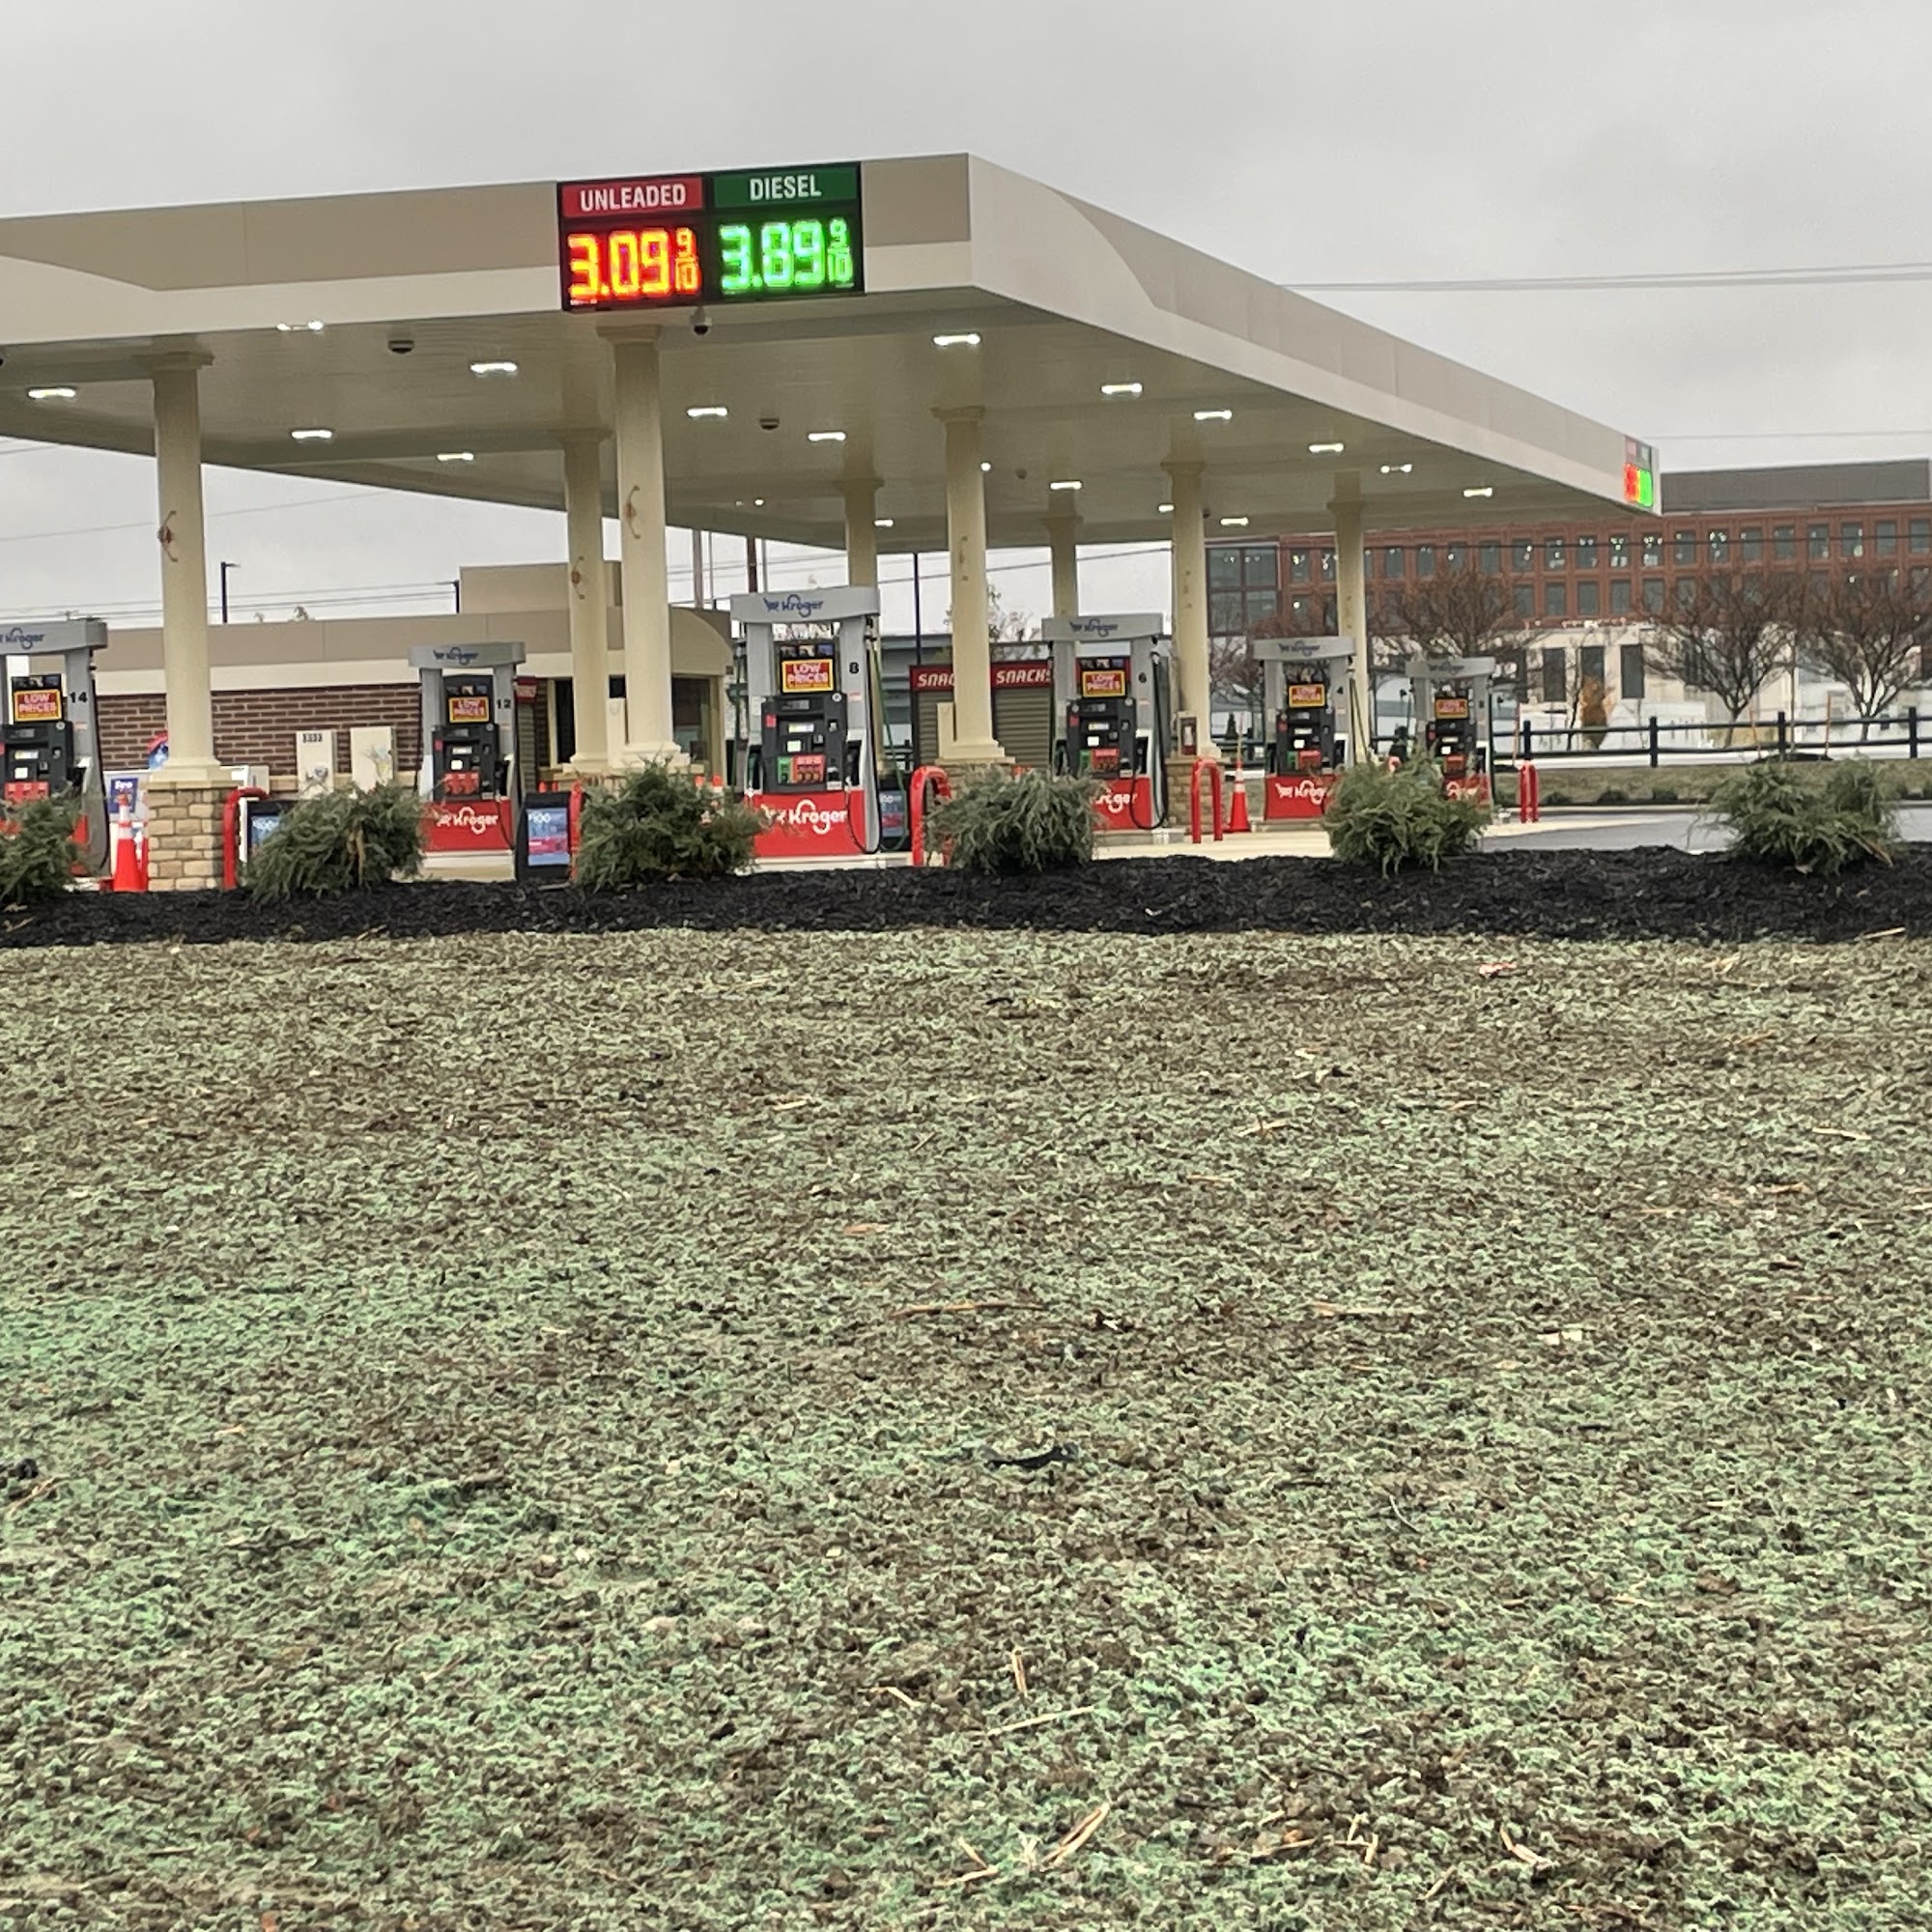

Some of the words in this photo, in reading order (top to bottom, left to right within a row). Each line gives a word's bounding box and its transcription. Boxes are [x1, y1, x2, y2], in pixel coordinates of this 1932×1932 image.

[581, 184, 686, 212] UNLEADED
[750, 174, 821, 201] DIESEL
[567, 228, 669, 298] 3.09
[720, 220, 823, 292] 3.89
[781, 594, 824, 618] Kroger
[849, 662, 860, 674] 8
[70, 691, 89, 703] 14
[497, 698, 511, 710] 12
[453, 806, 499, 835] Kroger
[789, 799, 848, 835] Kroger
